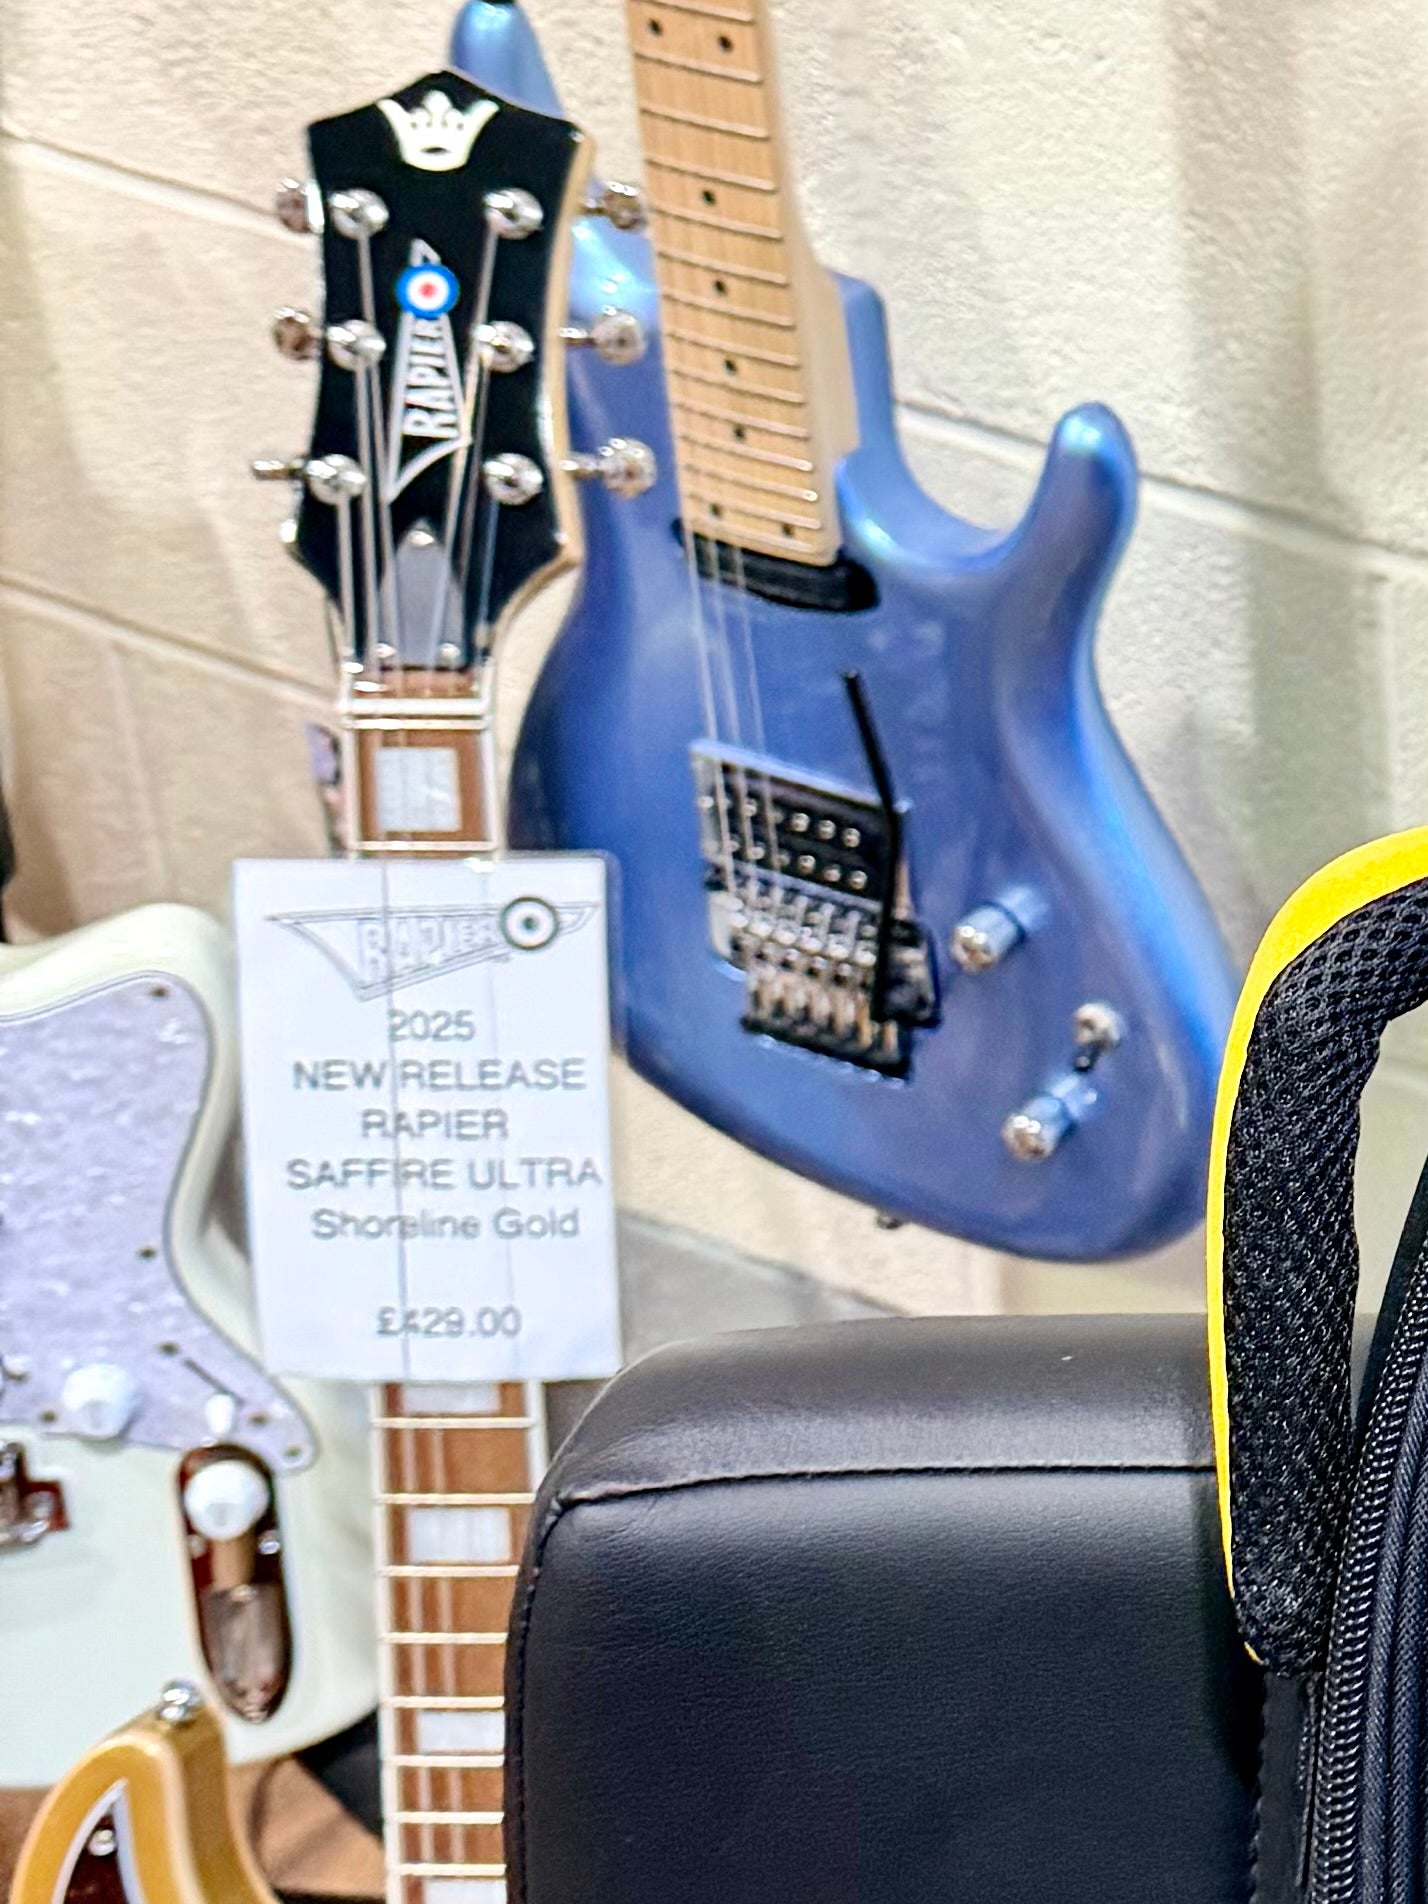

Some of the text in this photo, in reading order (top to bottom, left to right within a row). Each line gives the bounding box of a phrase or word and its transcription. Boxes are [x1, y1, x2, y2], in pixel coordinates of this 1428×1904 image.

[388, 1009, 476, 1043] 2025
[292, 1058, 588, 1092] NEW RELEASE
[360, 1109, 510, 1141] RAPIER
[286, 1157, 602, 1192] SAFFIRE ULTRA
[310, 1207, 581, 1241] Shoreline Gold
[375, 1306, 523, 1339] £429.00
